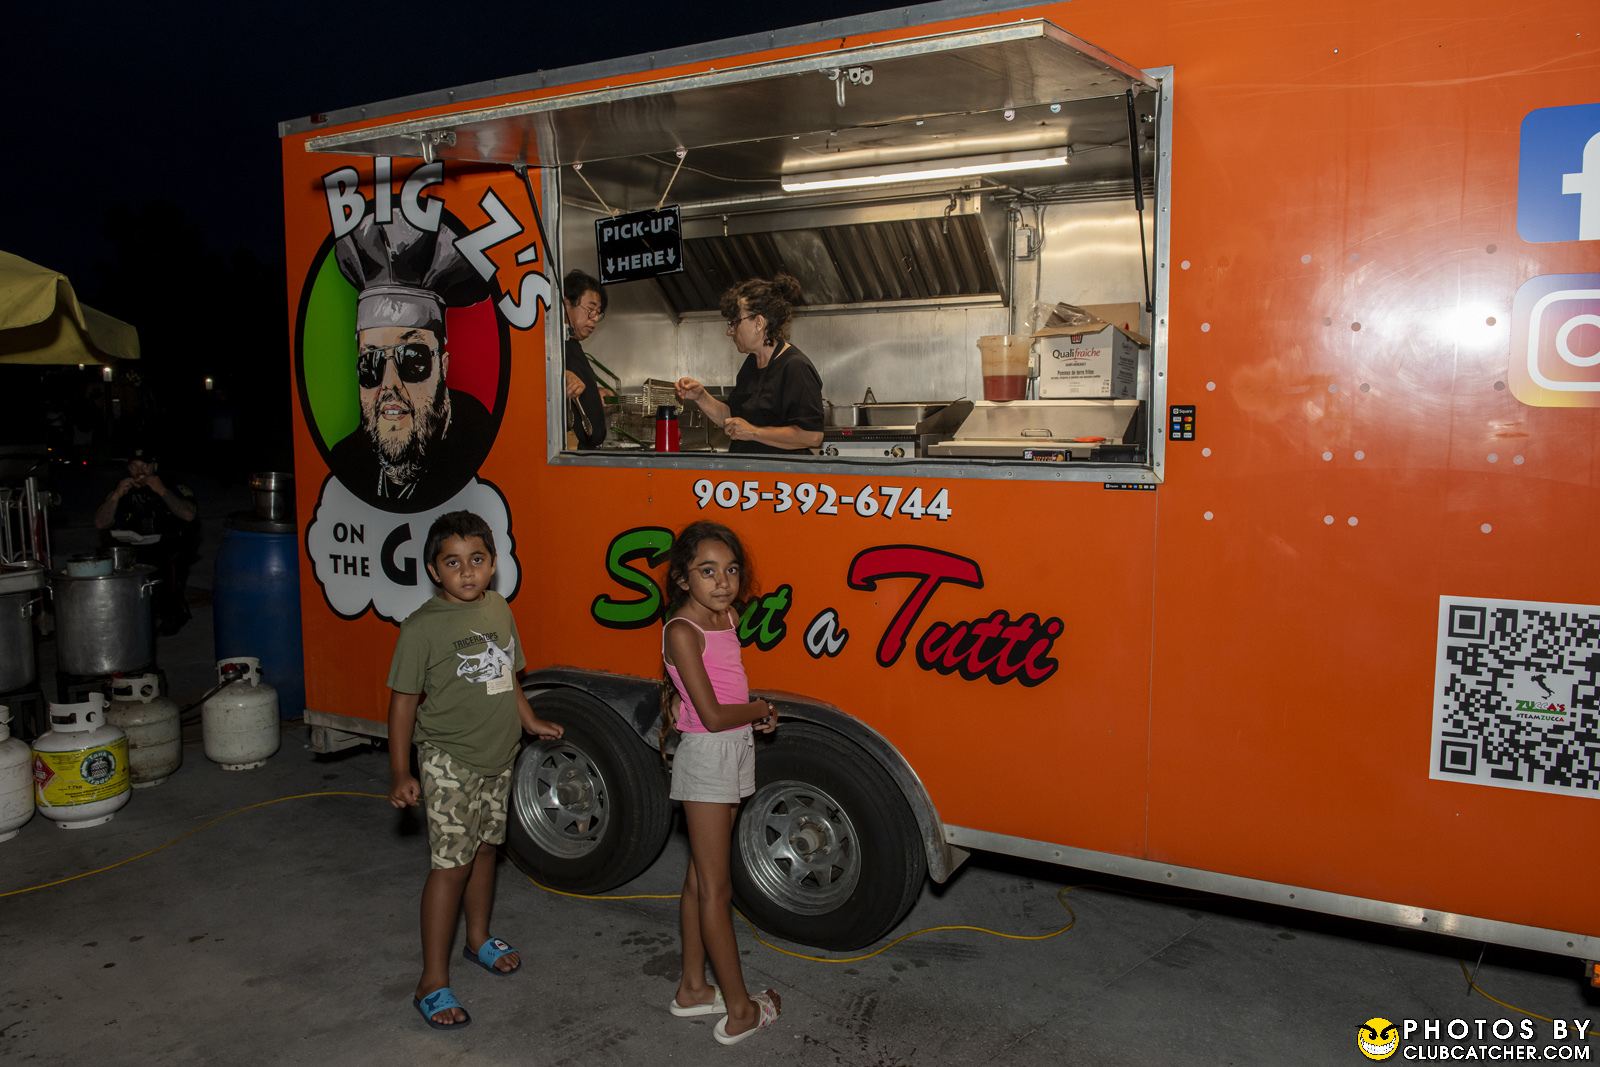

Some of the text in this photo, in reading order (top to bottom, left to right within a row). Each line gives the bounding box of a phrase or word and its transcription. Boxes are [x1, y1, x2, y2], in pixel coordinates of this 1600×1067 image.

[322, 156, 445, 240] BIG
[603, 216, 674, 242] PICK-UP
[617, 250, 665, 272] HERE
[693, 479, 952, 521] 905-392-6744
[333, 522, 365, 544] ON
[329, 553, 370, 577] THE
[381, 522, 443, 589] G
[803, 607, 849, 659] a
[847, 544, 1065, 688] Tutti
[1516, 713, 1565, 722] #TEAMZUCCA
